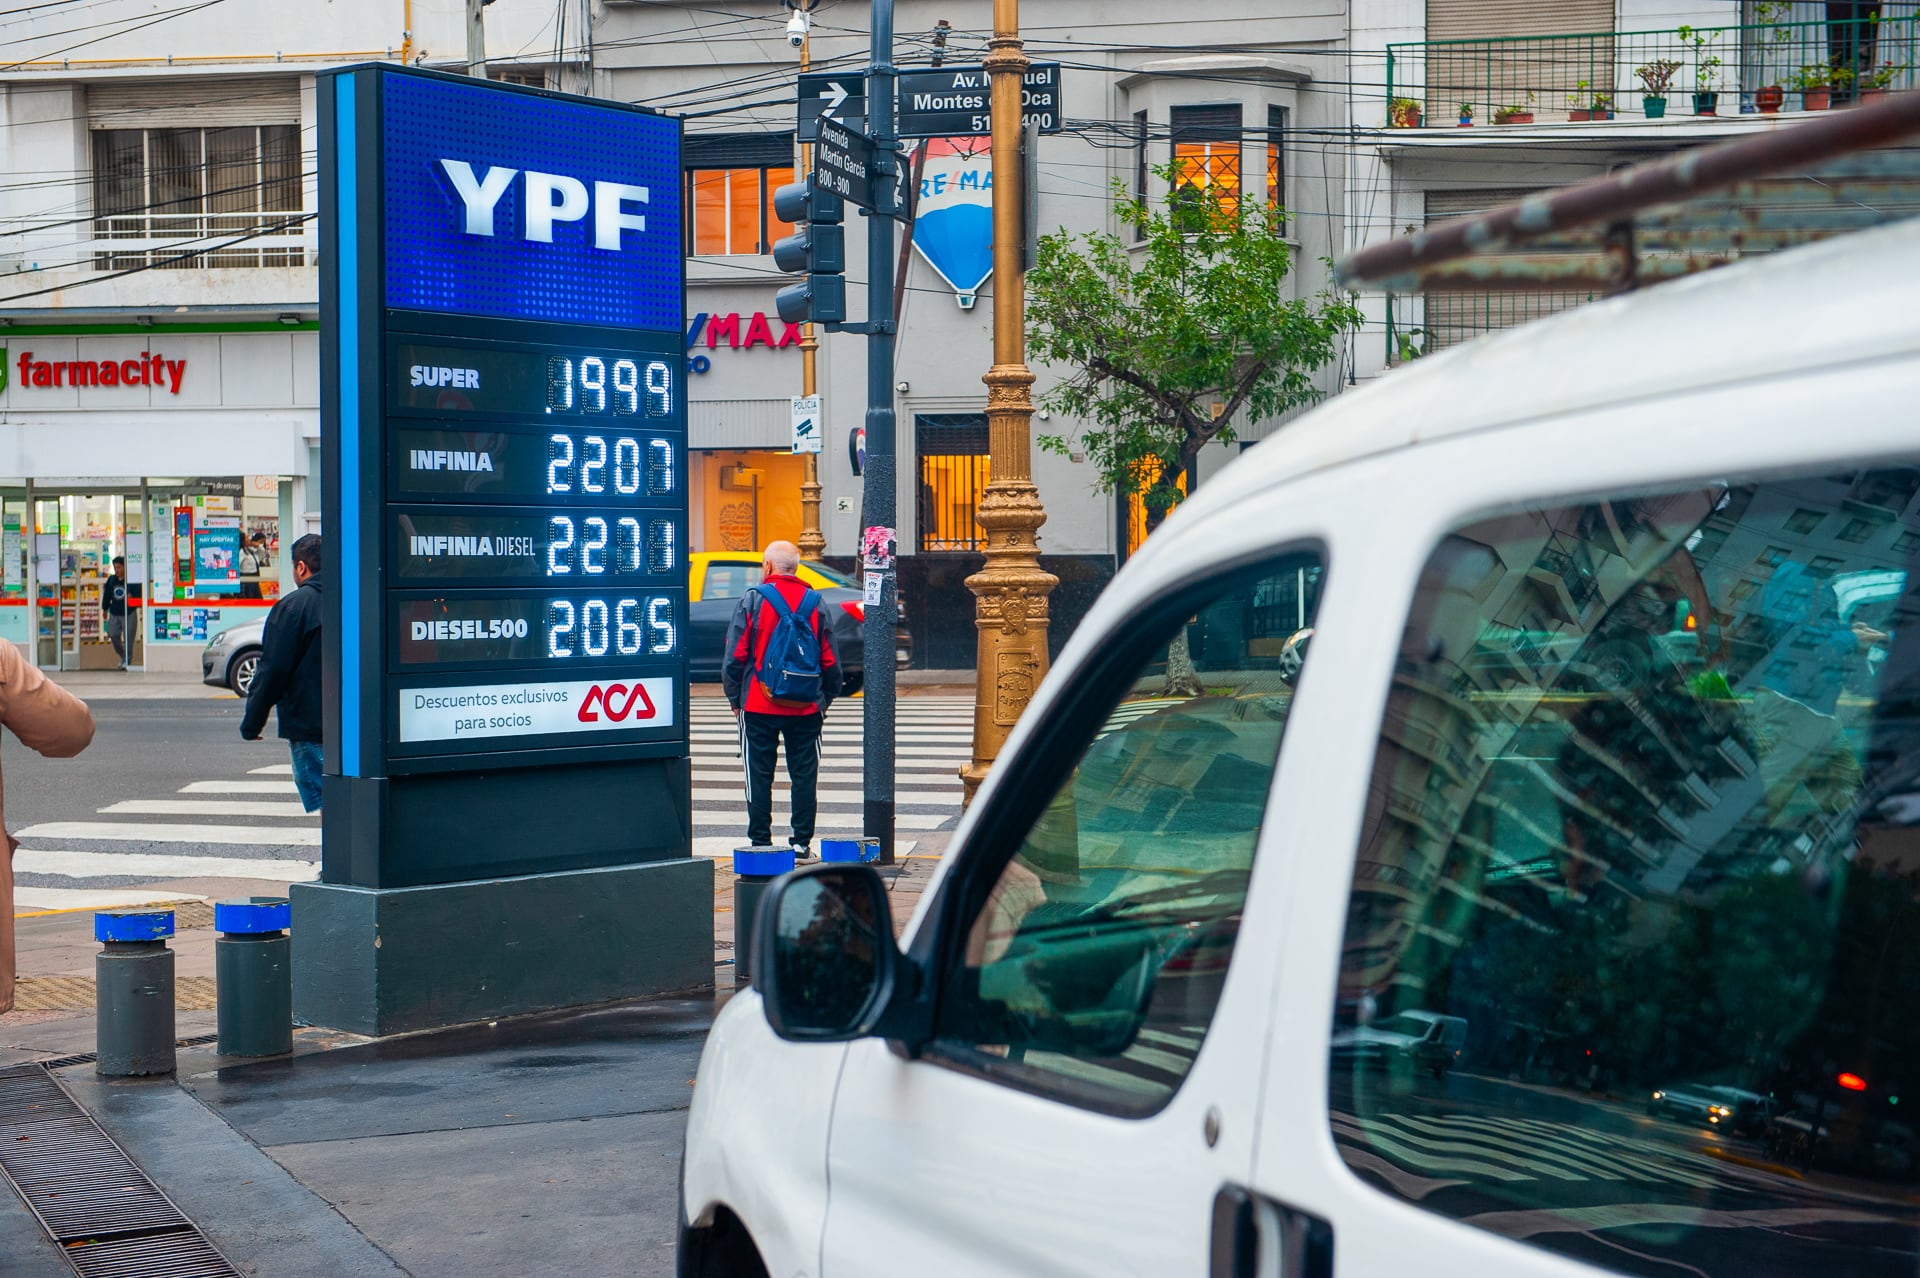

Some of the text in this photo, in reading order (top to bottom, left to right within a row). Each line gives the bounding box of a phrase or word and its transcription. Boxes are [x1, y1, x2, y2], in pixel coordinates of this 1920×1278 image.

[952, 68, 1052, 88] Av. Muel
[914, 94, 983, 110] Montes
[821, 121, 849, 149] Avenida
[844, 154, 866, 179] García
[818, 167, 832, 189] 800
[837, 175, 850, 195] 900
[440, 158, 650, 251] YPF
[17, 351, 186, 394] farmacity
[410, 365, 480, 389] SUPER
[410, 449, 494, 472] INFINIA
[410, 535, 494, 556] INFINIA
[496, 537, 536, 557] DIESEL
[414, 689, 568, 711] Descuentos exclusivos
[577, 683, 657, 723] ACA
[455, 715, 532, 733] para socios
